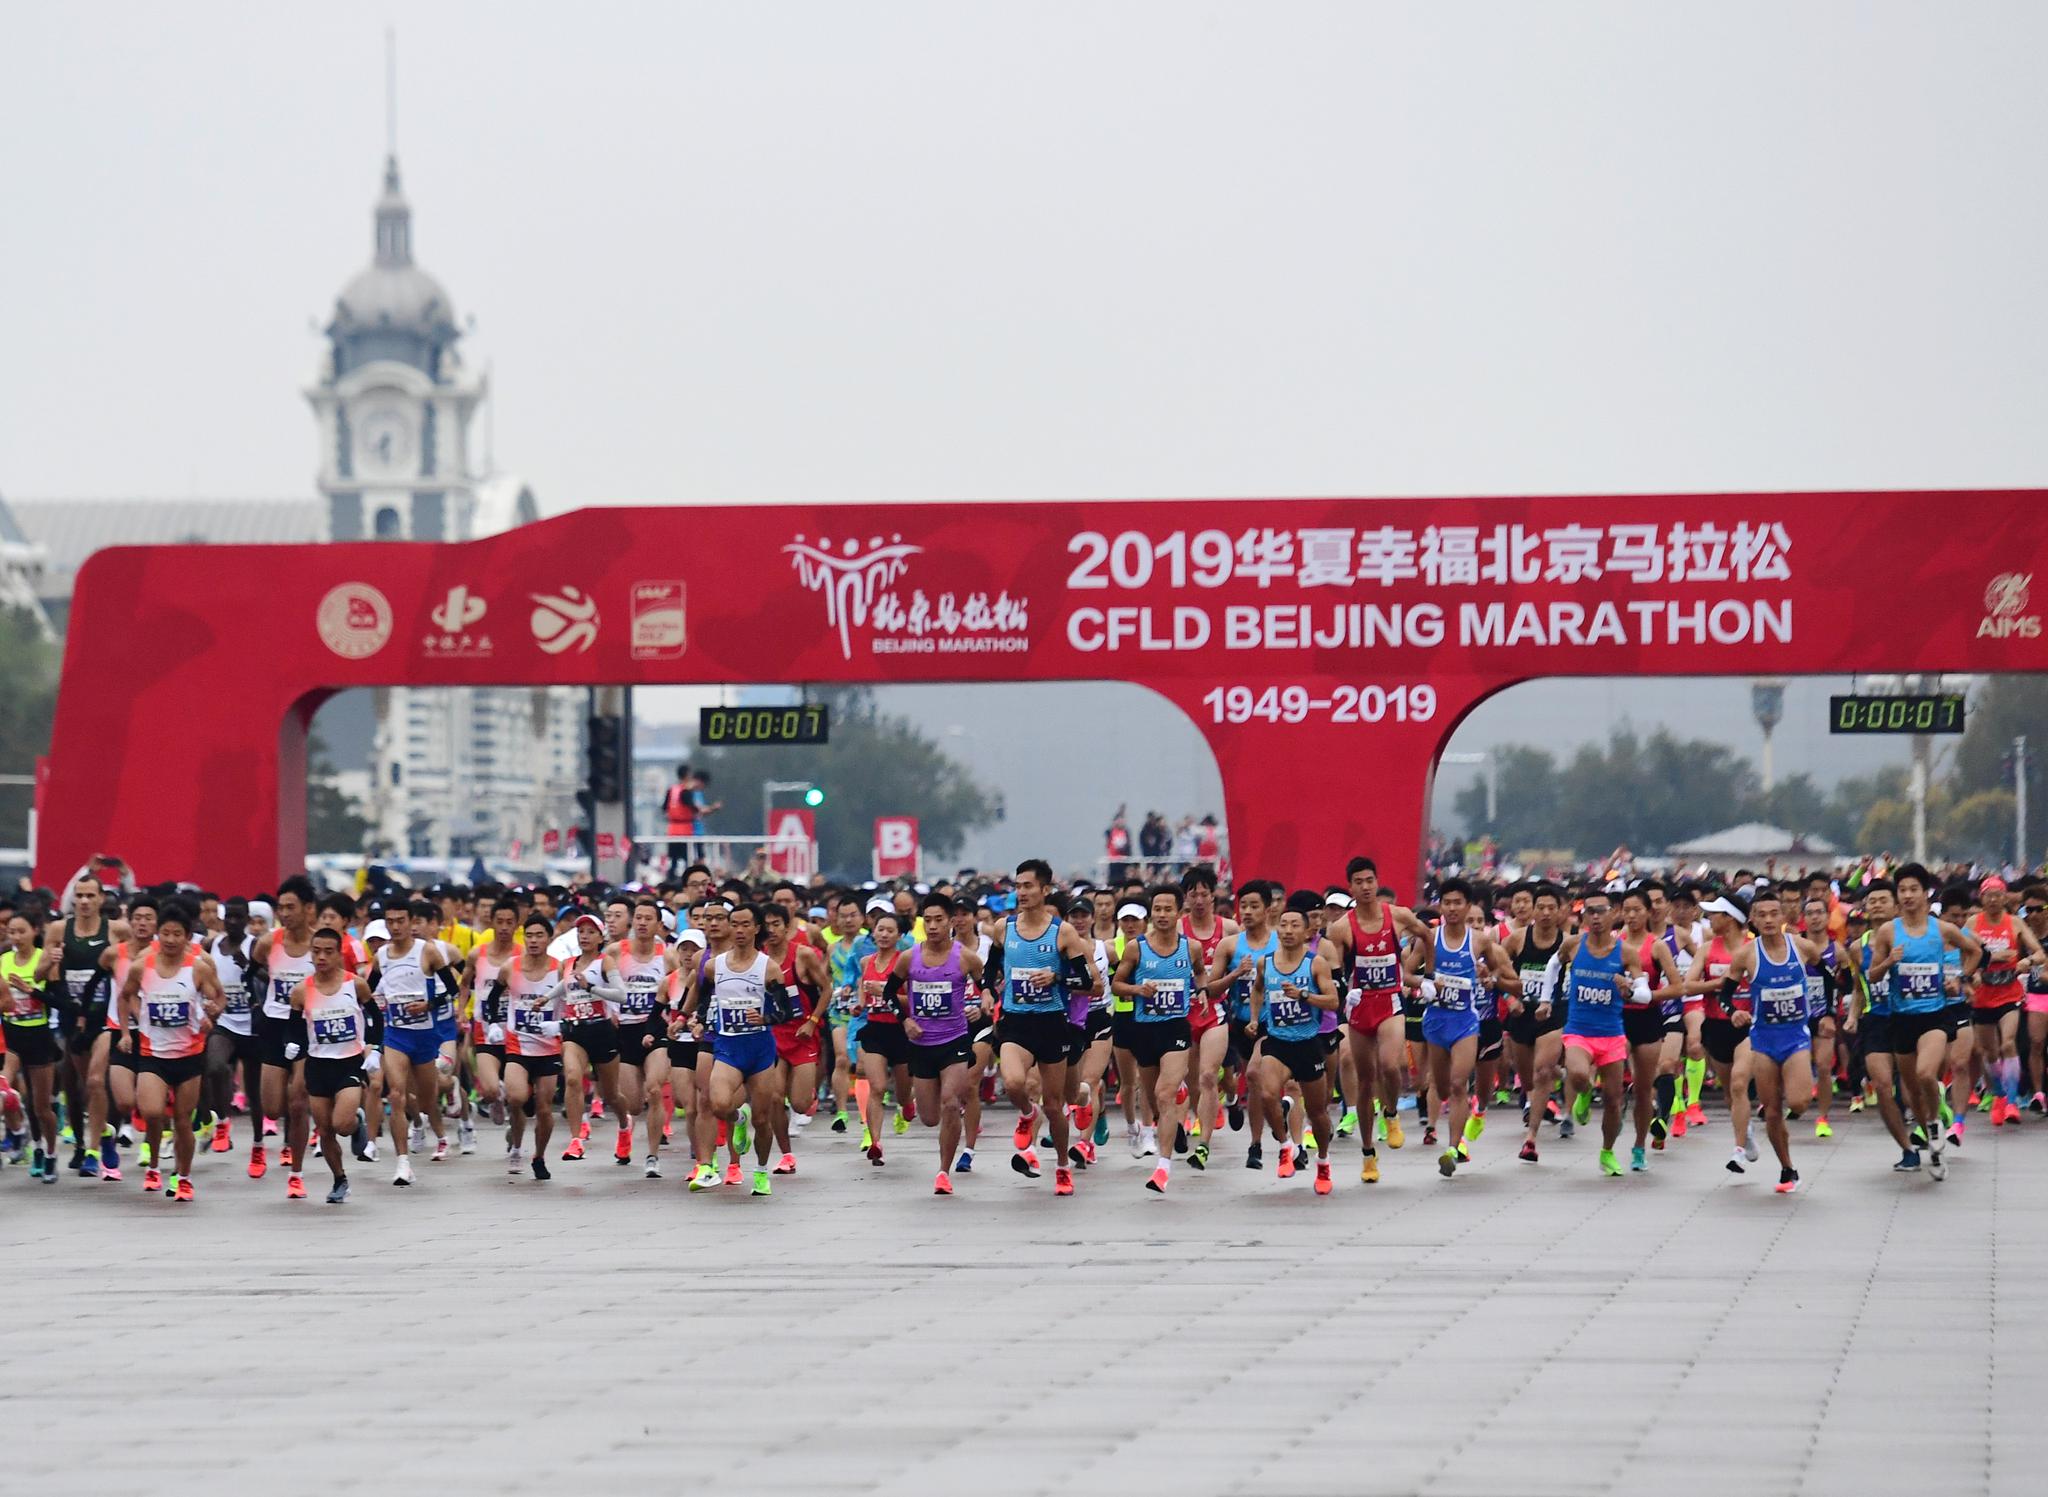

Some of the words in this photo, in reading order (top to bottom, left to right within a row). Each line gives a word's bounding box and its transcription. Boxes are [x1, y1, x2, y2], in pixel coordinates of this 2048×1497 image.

[1066, 521, 1793, 589] 2019华夏幸福北京马拉松
[1066, 605, 1212, 651] CFLD
[1224, 602, 1445, 649] BEIJING
[1458, 599, 1793, 646] MARATHON
[1975, 616, 2043, 638] AIMS
[872, 637, 934, 653] BEIJING
[938, 637, 1029, 652] MARATHON
[1202, 684, 1438, 724] 1949-2019
[1839, 700, 1957, 729] 0:00:07
[708, 711, 820, 740] 0:00:07
[772, 814, 811, 854] A
[880, 821, 914, 859] B
[1366, 967, 1387, 980] 101
[1908, 976, 1932, 990] 104
[629, 993, 649, 1006] 121
[920, 994, 942, 1008] 109
[1153, 991, 1175, 1006] 116
[156, 1003, 180, 1018] 122
[1278, 1001, 1301, 1016] 114
[1773, 1000, 1796, 1014] 105
[729, 1009, 749, 1023] 11
[323, 1018, 347, 1034] 126
